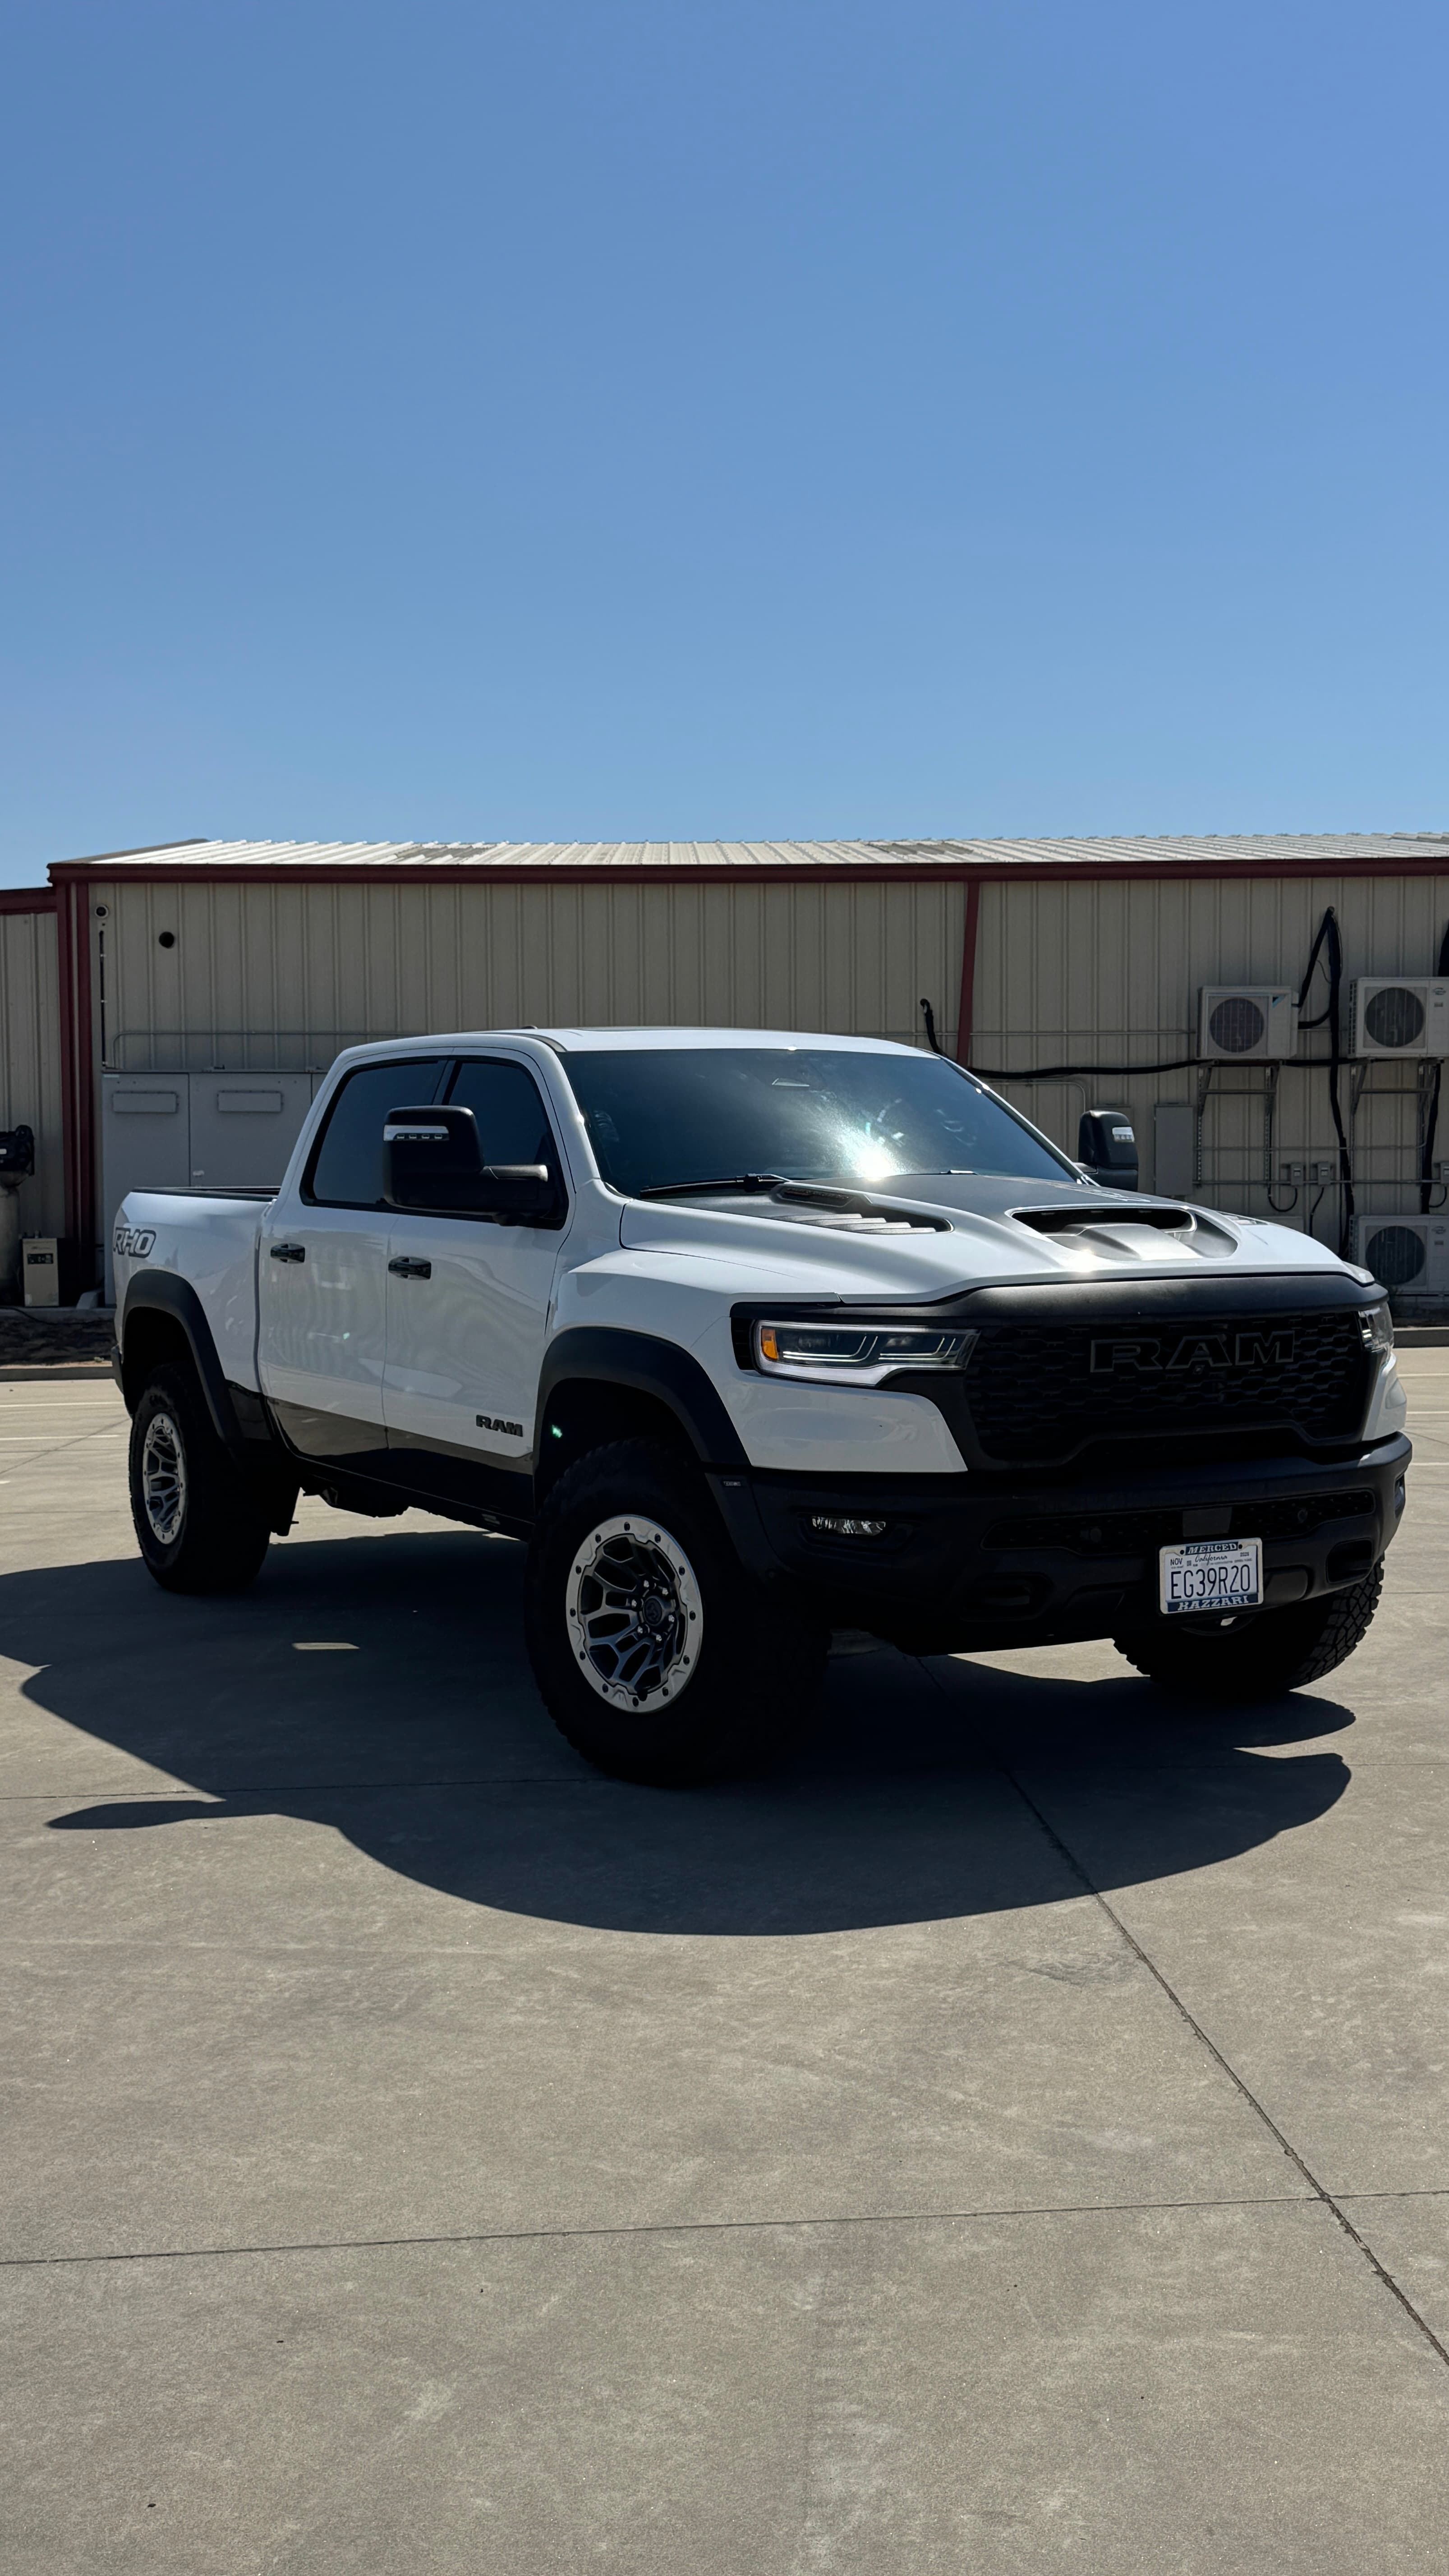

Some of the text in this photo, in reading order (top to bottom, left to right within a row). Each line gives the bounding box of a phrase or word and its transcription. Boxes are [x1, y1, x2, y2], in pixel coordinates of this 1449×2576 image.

[113, 1226, 156, 1258] RHO
[1090, 1330, 1295, 1373] RAM
[476, 1414, 523, 1437] RAM
[1187, 1543, 1237, 1554] MERCED
[1195, 1554, 1228, 1566] California
[1170, 1558, 1183, 1566] NOV
[1171, 1564, 1250, 1599] EG39R20
